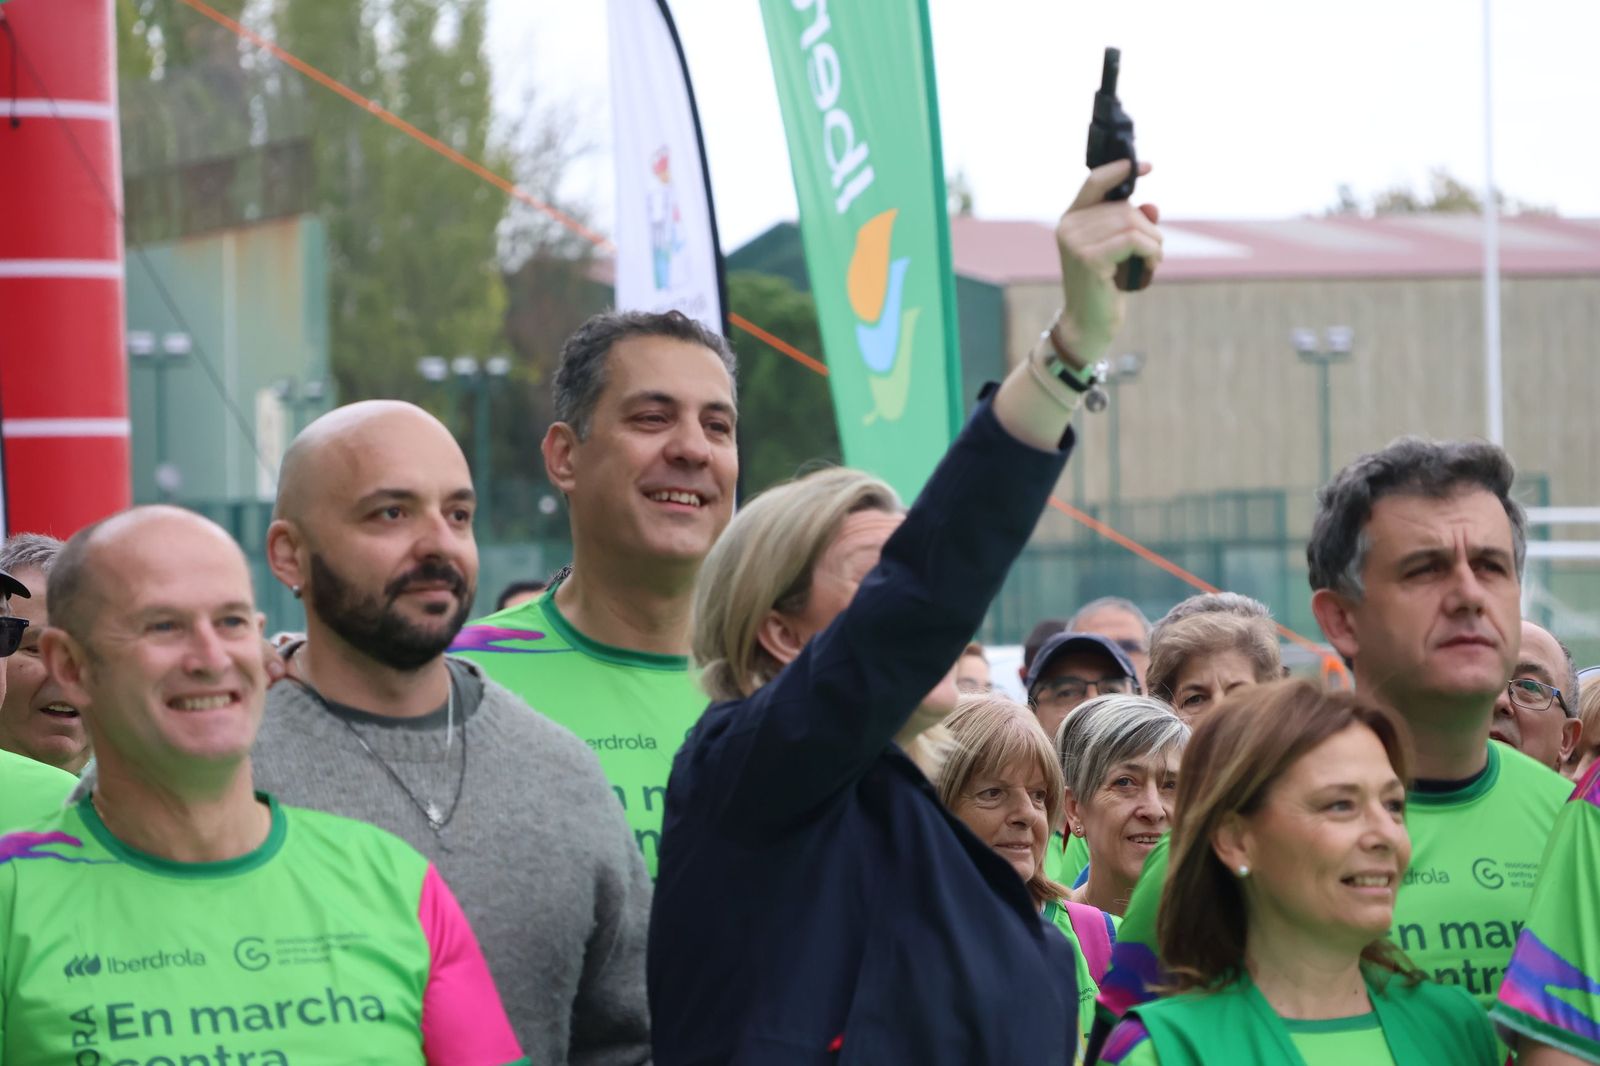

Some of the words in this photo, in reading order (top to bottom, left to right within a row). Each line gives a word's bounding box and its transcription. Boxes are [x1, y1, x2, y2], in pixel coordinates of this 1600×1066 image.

[107, 948, 206, 974] Iberdrola
[106, 1002, 173, 1042] En
[190, 987, 385, 1035] marcha
